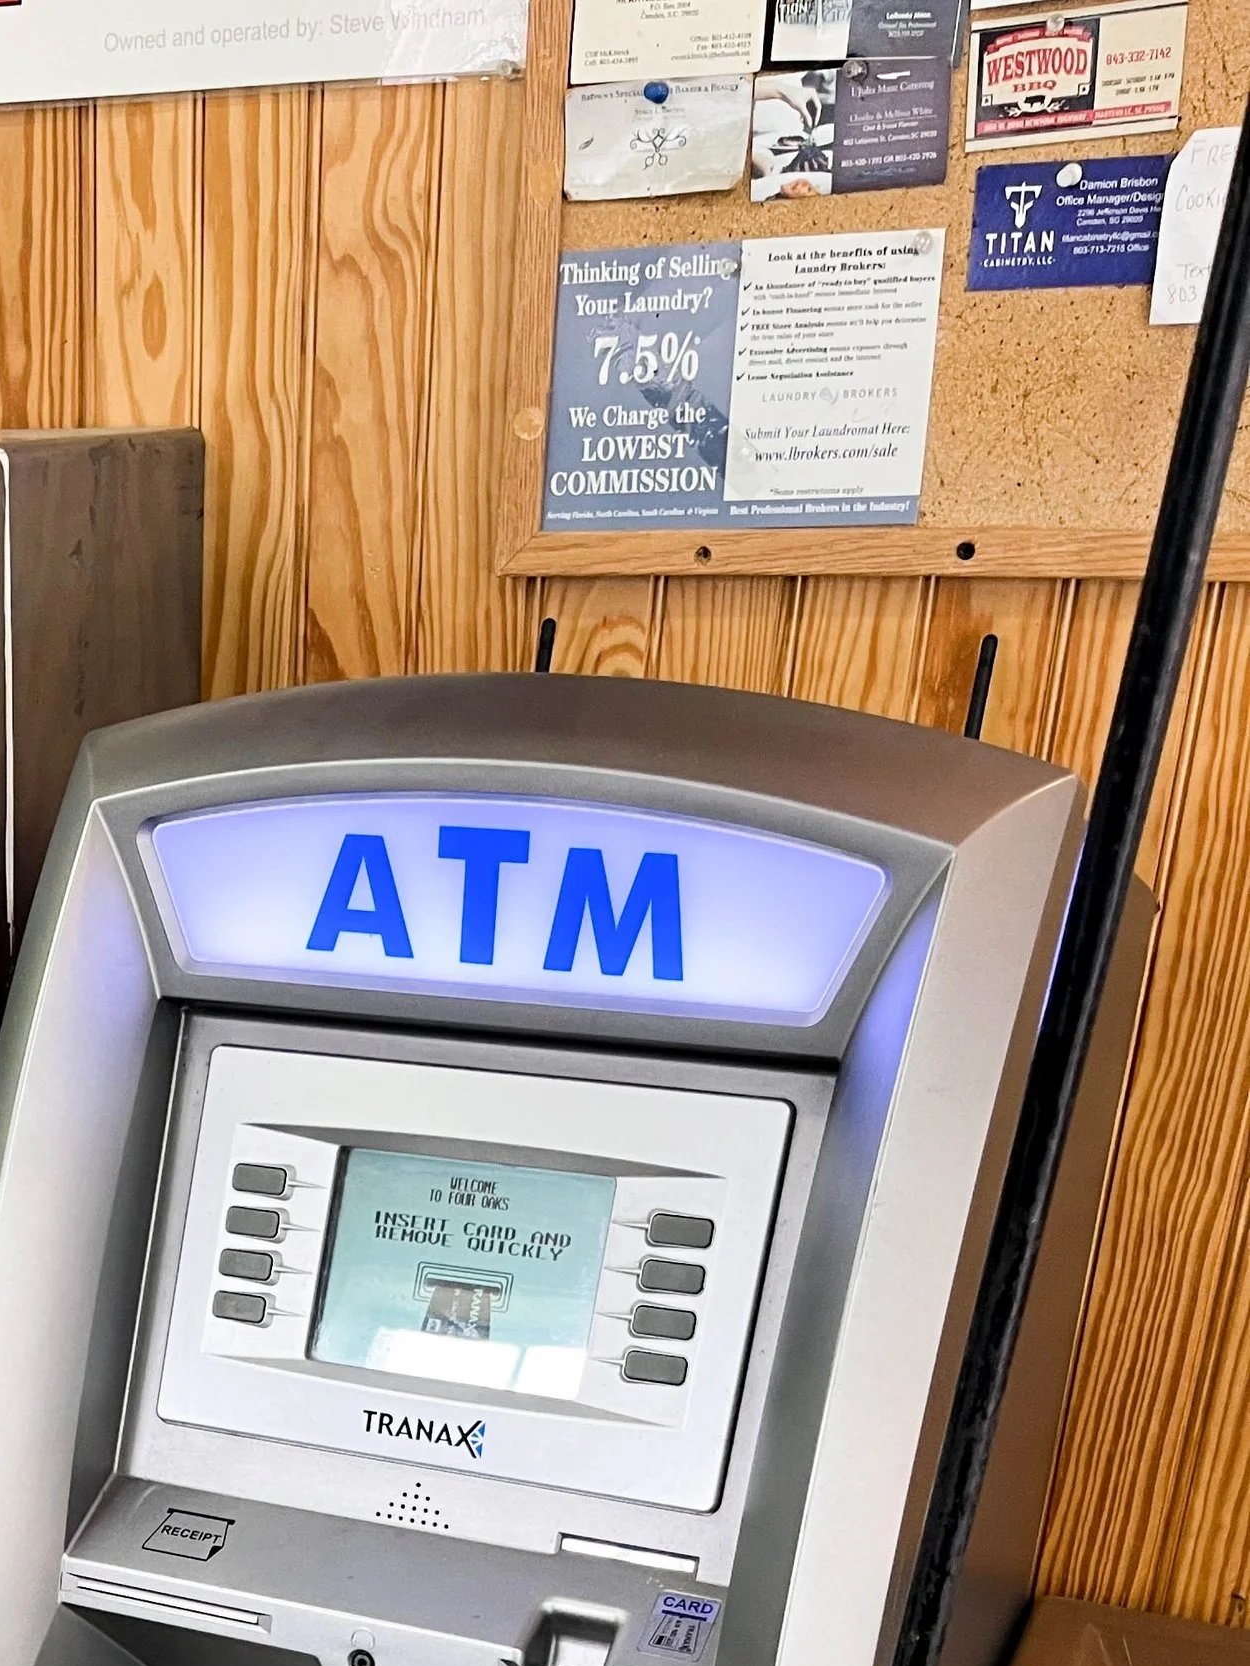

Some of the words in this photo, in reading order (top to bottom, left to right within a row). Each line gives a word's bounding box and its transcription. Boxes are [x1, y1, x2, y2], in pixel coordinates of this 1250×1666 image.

[103, 28, 167, 53] Owned
[171, 24, 205, 47] and
[210, 18, 290, 48] operated
[295, 14, 324, 39] by:
[329, 14, 384, 35] Steve
[987, 46, 1088, 87] WESTWOOD
[1106, 46, 1172, 66] 843-332-7142
[1012, 79, 1057, 93] BBQ
[1080, 179, 1118, 190] Damion
[1120, 177, 1159, 189] Brisbon
[1056, 194, 1085, 206] Office
[1086, 191, 1165, 206] Manager/Desig
[768, 251, 793, 262] Look
[795, 250, 807, 260] at
[810, 250, 827, 260] the
[830, 247, 873, 259] benefits
[876, 245, 889, 256] of
[985, 230, 1054, 255] TITAN
[1127, 243, 1150, 252] Office
[560, 260, 641, 286] Thinking
[645, 257, 667, 280] of
[669, 254, 733, 280] Selling
[795, 263, 837, 274] Laundry
[840, 261, 886, 271] Brokers:
[873, 275, 908, 285] qualified
[910, 275, 935, 284] buyers
[575, 294, 618, 316] Your
[623, 287, 713, 313] Laundry?
[594, 330, 700, 385] 7.5%
[761, 391, 817, 403] LAUNDRY
[842, 387, 898, 399] BROKERS
[569, 406, 597, 427] We
[602, 404, 668, 430] Charge
[675, 402, 706, 424] the
[745, 427, 781, 441] Submit
[785, 426, 810, 440] Your
[812, 423, 878, 438] Laundromat
[881, 422, 910, 435] Here:
[581, 434, 691, 462] LOWEST
[754, 443, 898, 462] www.lbrokers.com/sale
[550, 466, 718, 496] COMMISSION
[729, 504, 749, 516] Best
[750, 504, 803, 515] Professional
[804, 503, 840, 513] Brokers
[841, 502, 850, 513] in
[852, 501, 867, 511] the
[869, 500, 910, 512] Industry!
[306, 825, 684, 981] ATM
[450, 1177, 497, 1194] WELCOME
[430, 1189, 442, 1202] TO
[449, 1191, 476, 1207] FOUR
[481, 1195, 510, 1211] OAKS
[375, 1211, 449, 1233] INSERT
[463, 1222, 517, 1241] CARD
[531, 1231, 572, 1248] AND
[375, 1225, 454, 1248] REMOVE
[467, 1237, 563, 1261] QUICKLY
[363, 1410, 486, 1459] TRANAX
[160, 1523, 223, 1545] RECEIPT
[663, 1596, 713, 1614] CARD
